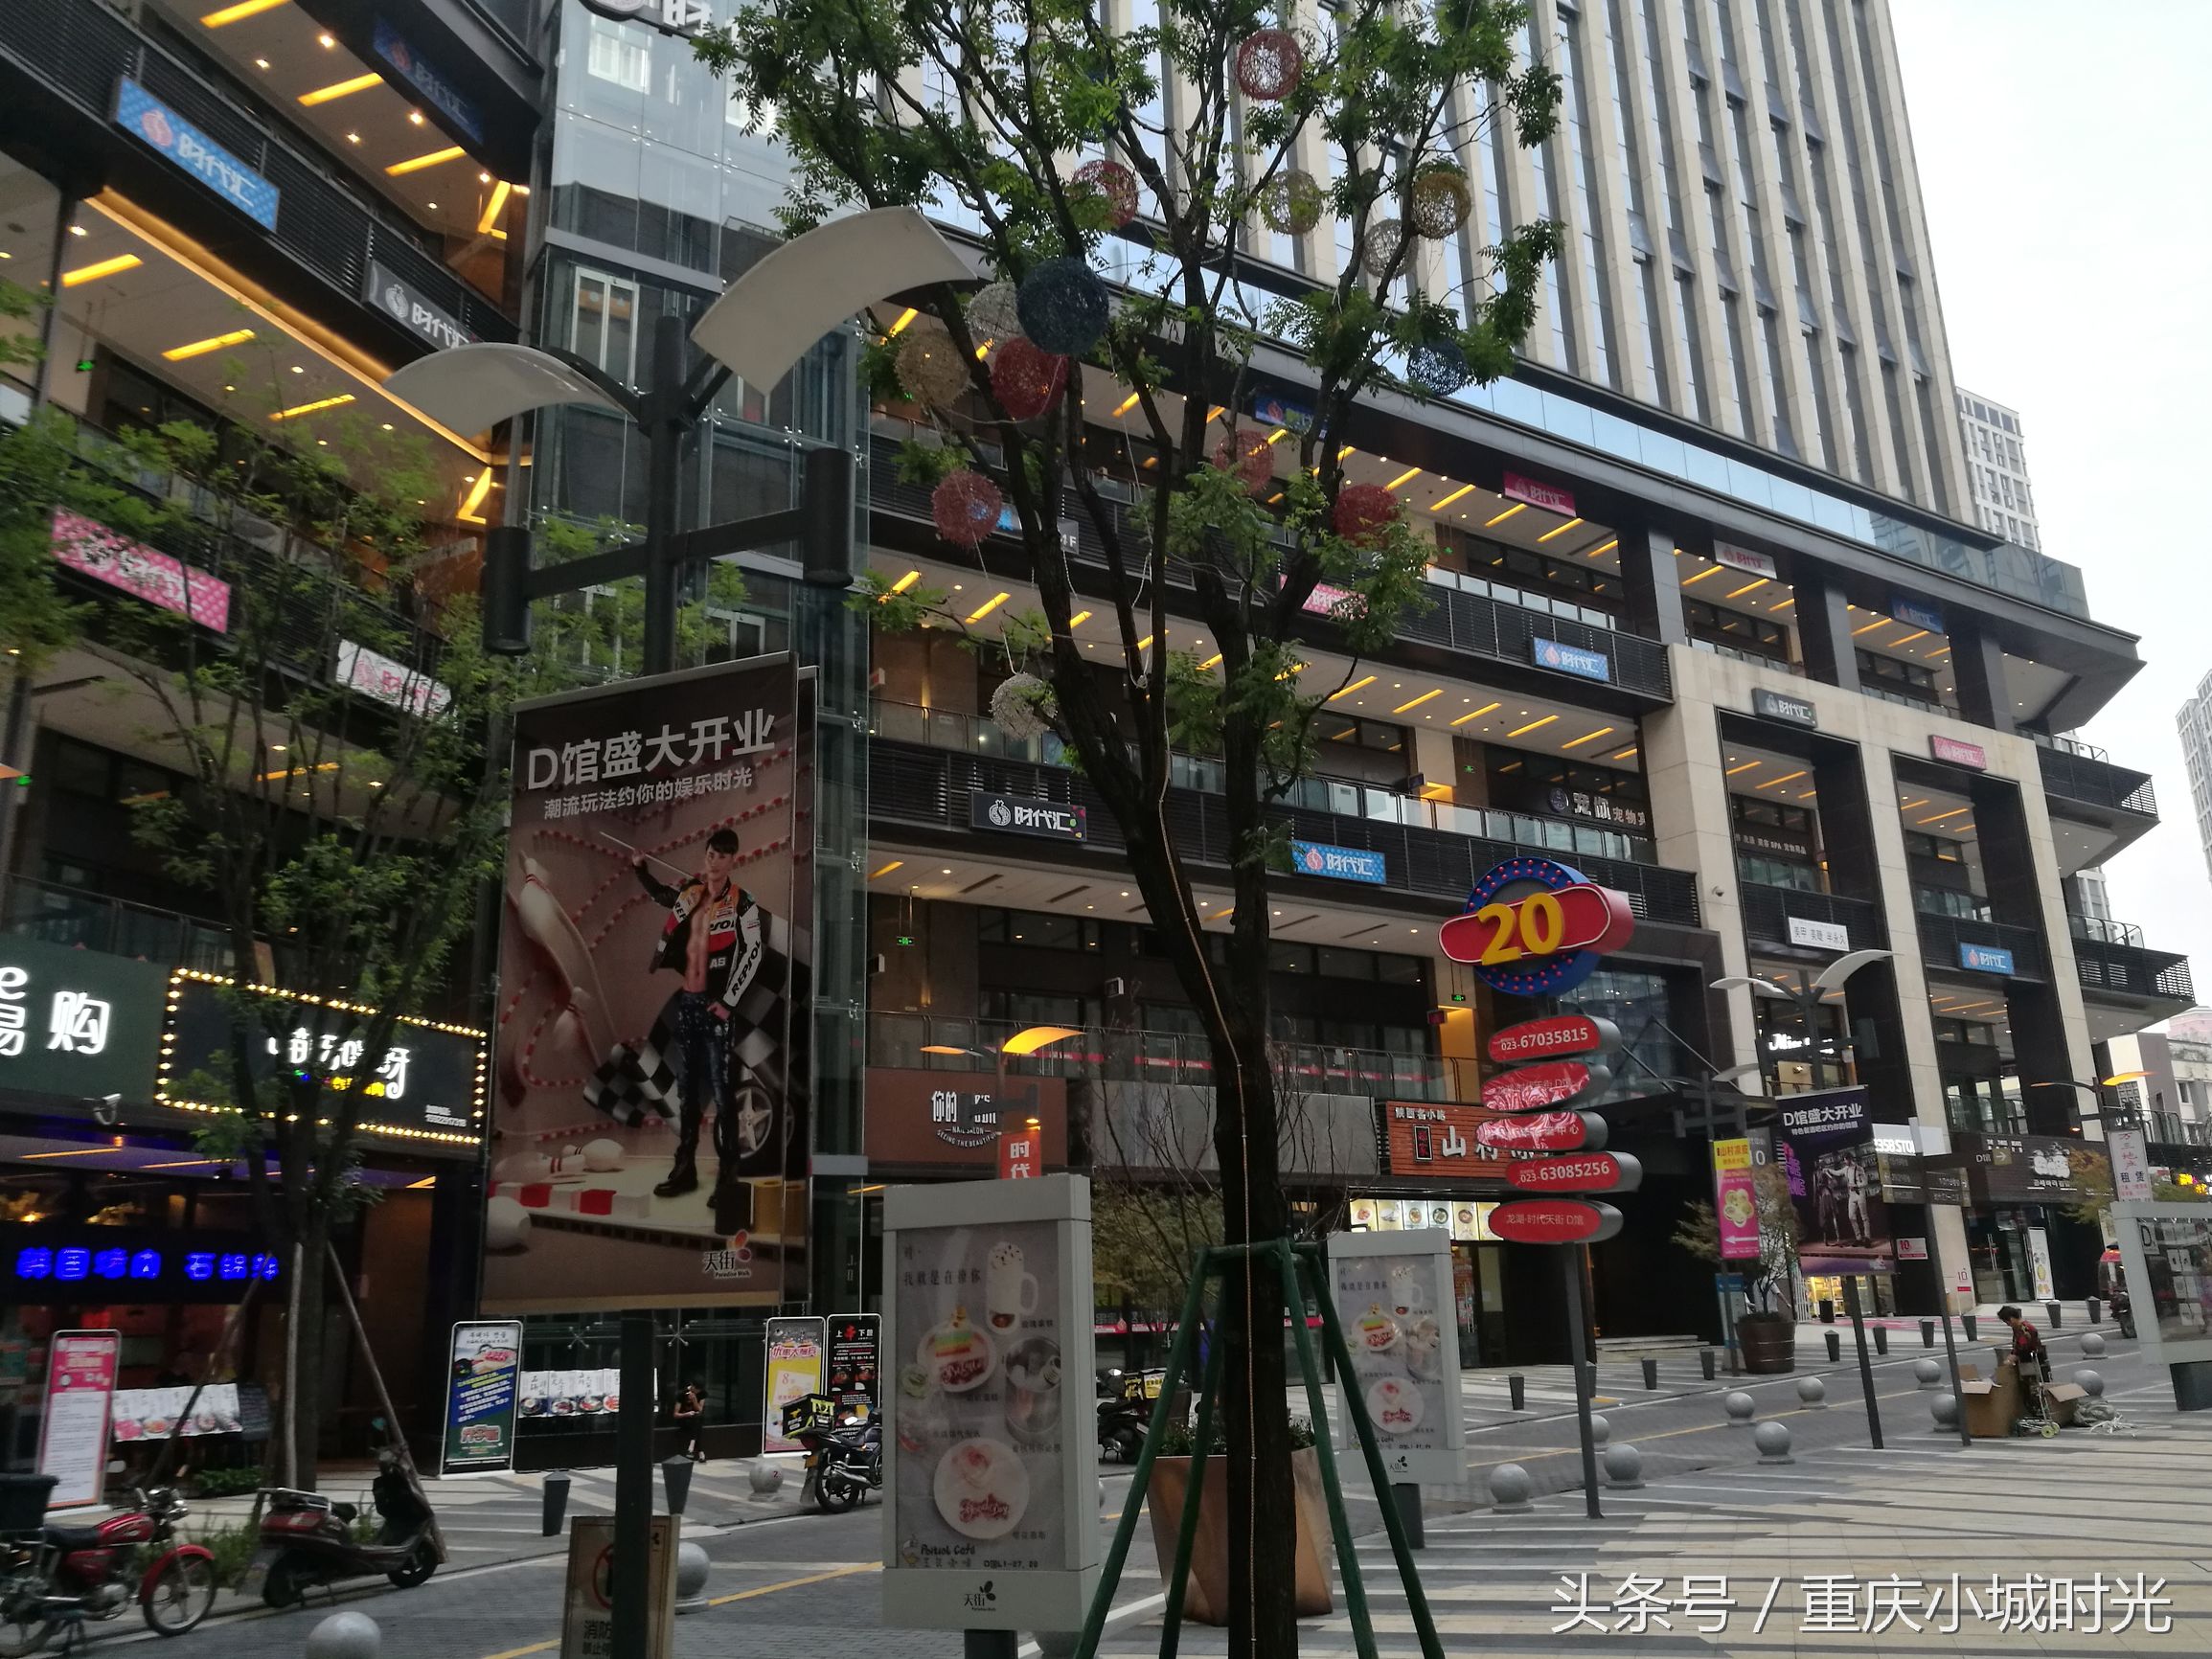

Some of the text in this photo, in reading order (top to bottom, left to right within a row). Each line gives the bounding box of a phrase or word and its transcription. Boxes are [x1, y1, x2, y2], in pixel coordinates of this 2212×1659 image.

[528, 708, 775, 790] D馆盛大开业
[543, 766, 753, 821] 潮流玩法约你的娱乐时光
[1015, 806, 1072, 831] 时代汇
[1327, 852, 1374, 876] 时代汇
[1477, 892, 1564, 966] 20
[732, 940, 761, 997] REPSOL
[1501, 1027, 1588, 1051] 023-67035815
[931, 1090, 957, 1123] 你的
[1783, 1102, 1863, 1126] D馆盛大开业
[1520, 1161, 1610, 1183] 023-63085256
[704, 1251, 735, 1272] 天街
[964, 1593, 985, 1607] 天街
